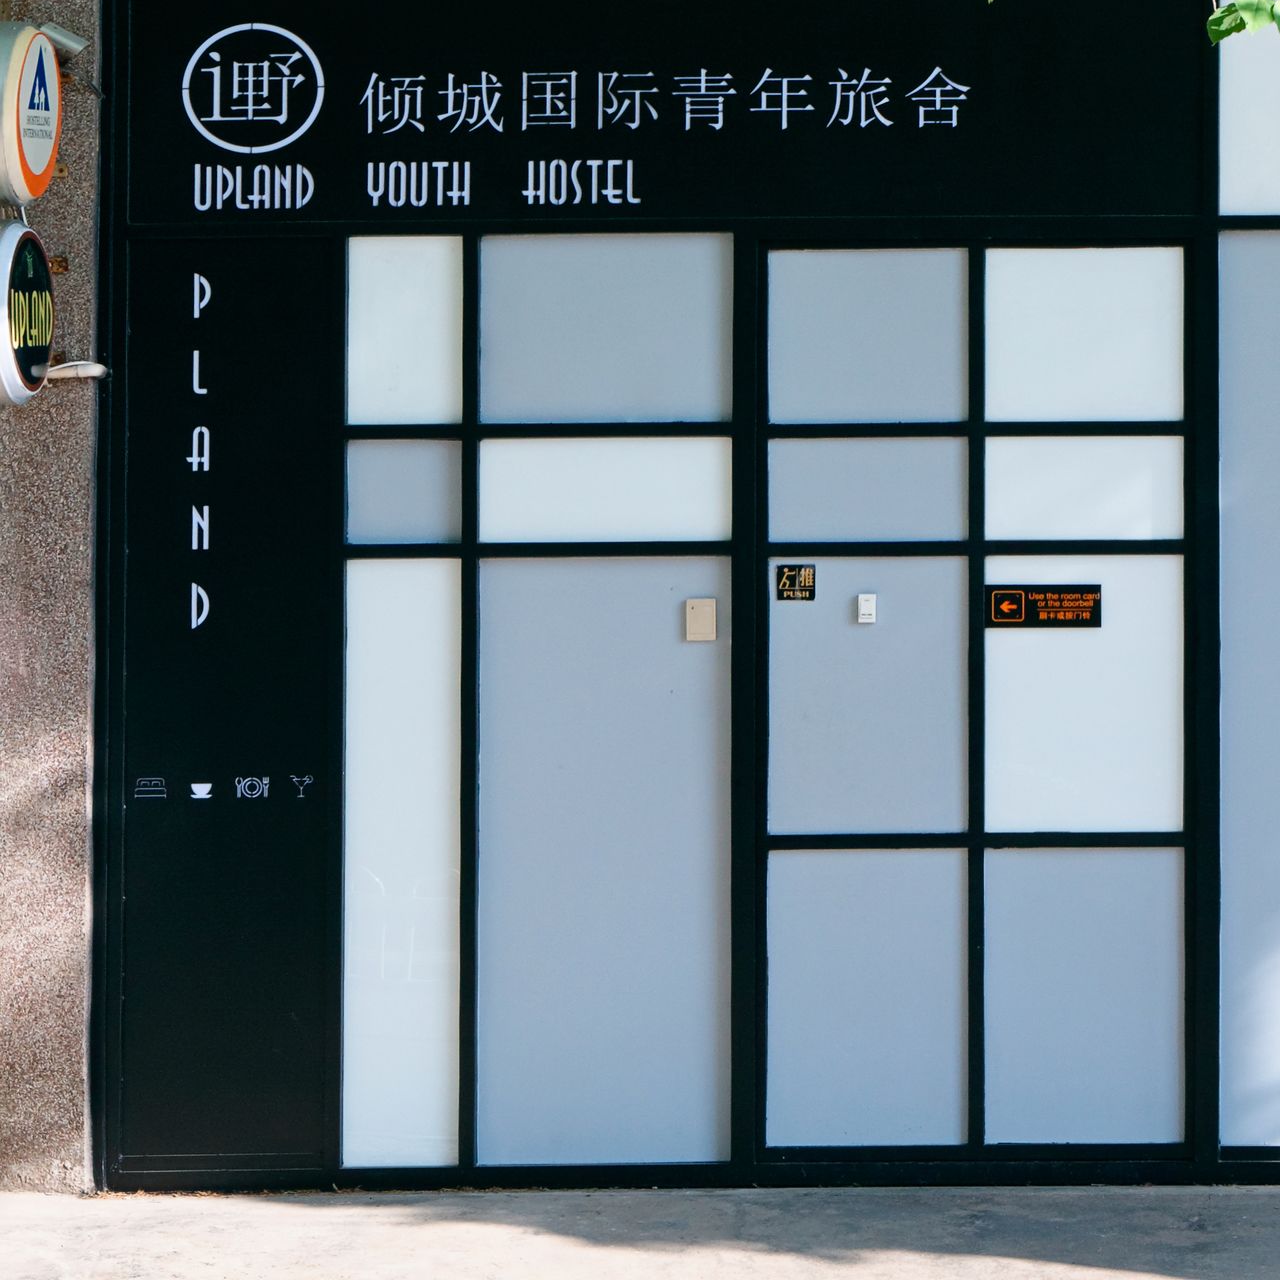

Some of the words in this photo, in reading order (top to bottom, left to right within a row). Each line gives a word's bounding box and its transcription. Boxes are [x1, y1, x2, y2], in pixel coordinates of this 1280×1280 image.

[359, 66, 971, 134] 倾城国际青年旅舍
[194, 163, 315, 212] UPLAND
[367, 160, 471, 208] YOUTH
[521, 159, 641, 206] HOSTEL
[11, 289, 53, 349] UPLAND
[783, 590, 809, 598] PUSH
[800, 567, 814, 587] 推
[1028, 592, 1044, 600] Use
[1046, 592, 1059, 600] the
[1082, 592, 1100, 600] card
